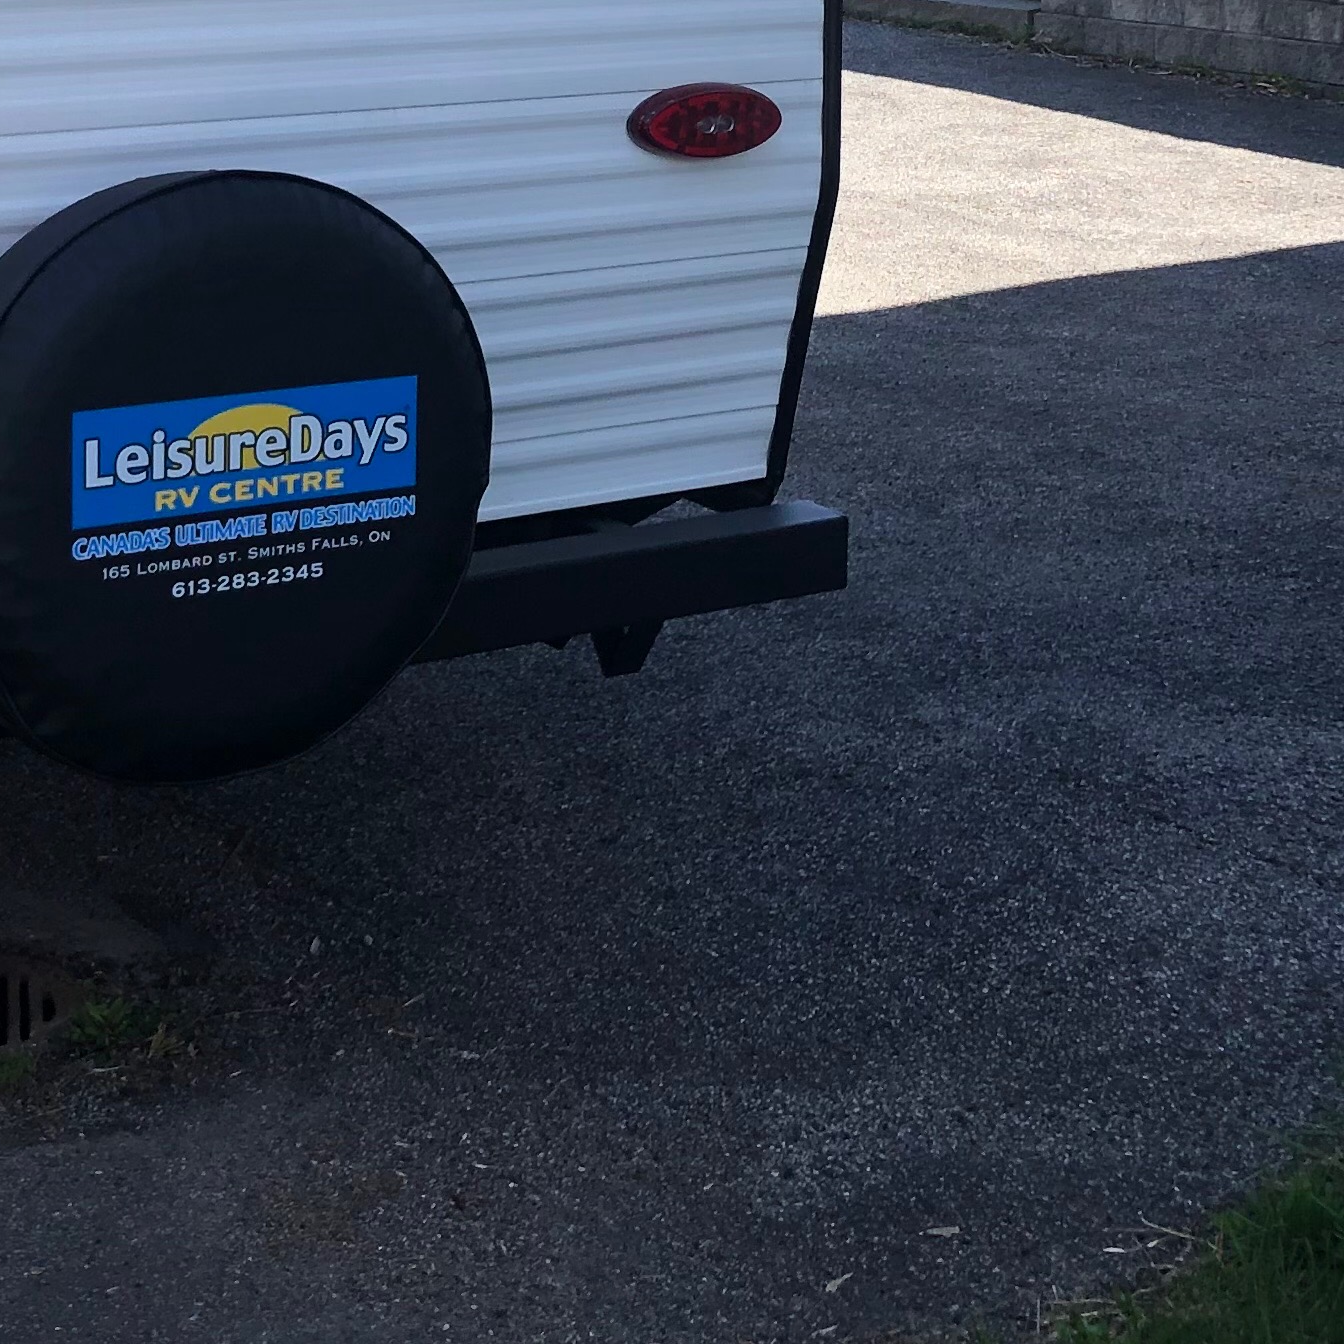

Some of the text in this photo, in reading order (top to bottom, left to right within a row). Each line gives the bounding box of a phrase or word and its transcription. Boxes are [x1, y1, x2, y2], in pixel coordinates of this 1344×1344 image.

[84, 413, 409, 490] LeisureDays
[154, 467, 345, 512] RV CENTRE
[72, 494, 416, 561] CANADA'S ULTIMATE RV DESTINATION
[102, 564, 131, 581] 165
[137, 554, 213, 575] LOMBARD
[218, 551, 243, 564] ST.
[247, 540, 306, 560] SMITHS
[311, 534, 364, 551] FALLS,
[171, 561, 324, 599] 613-283-2345
